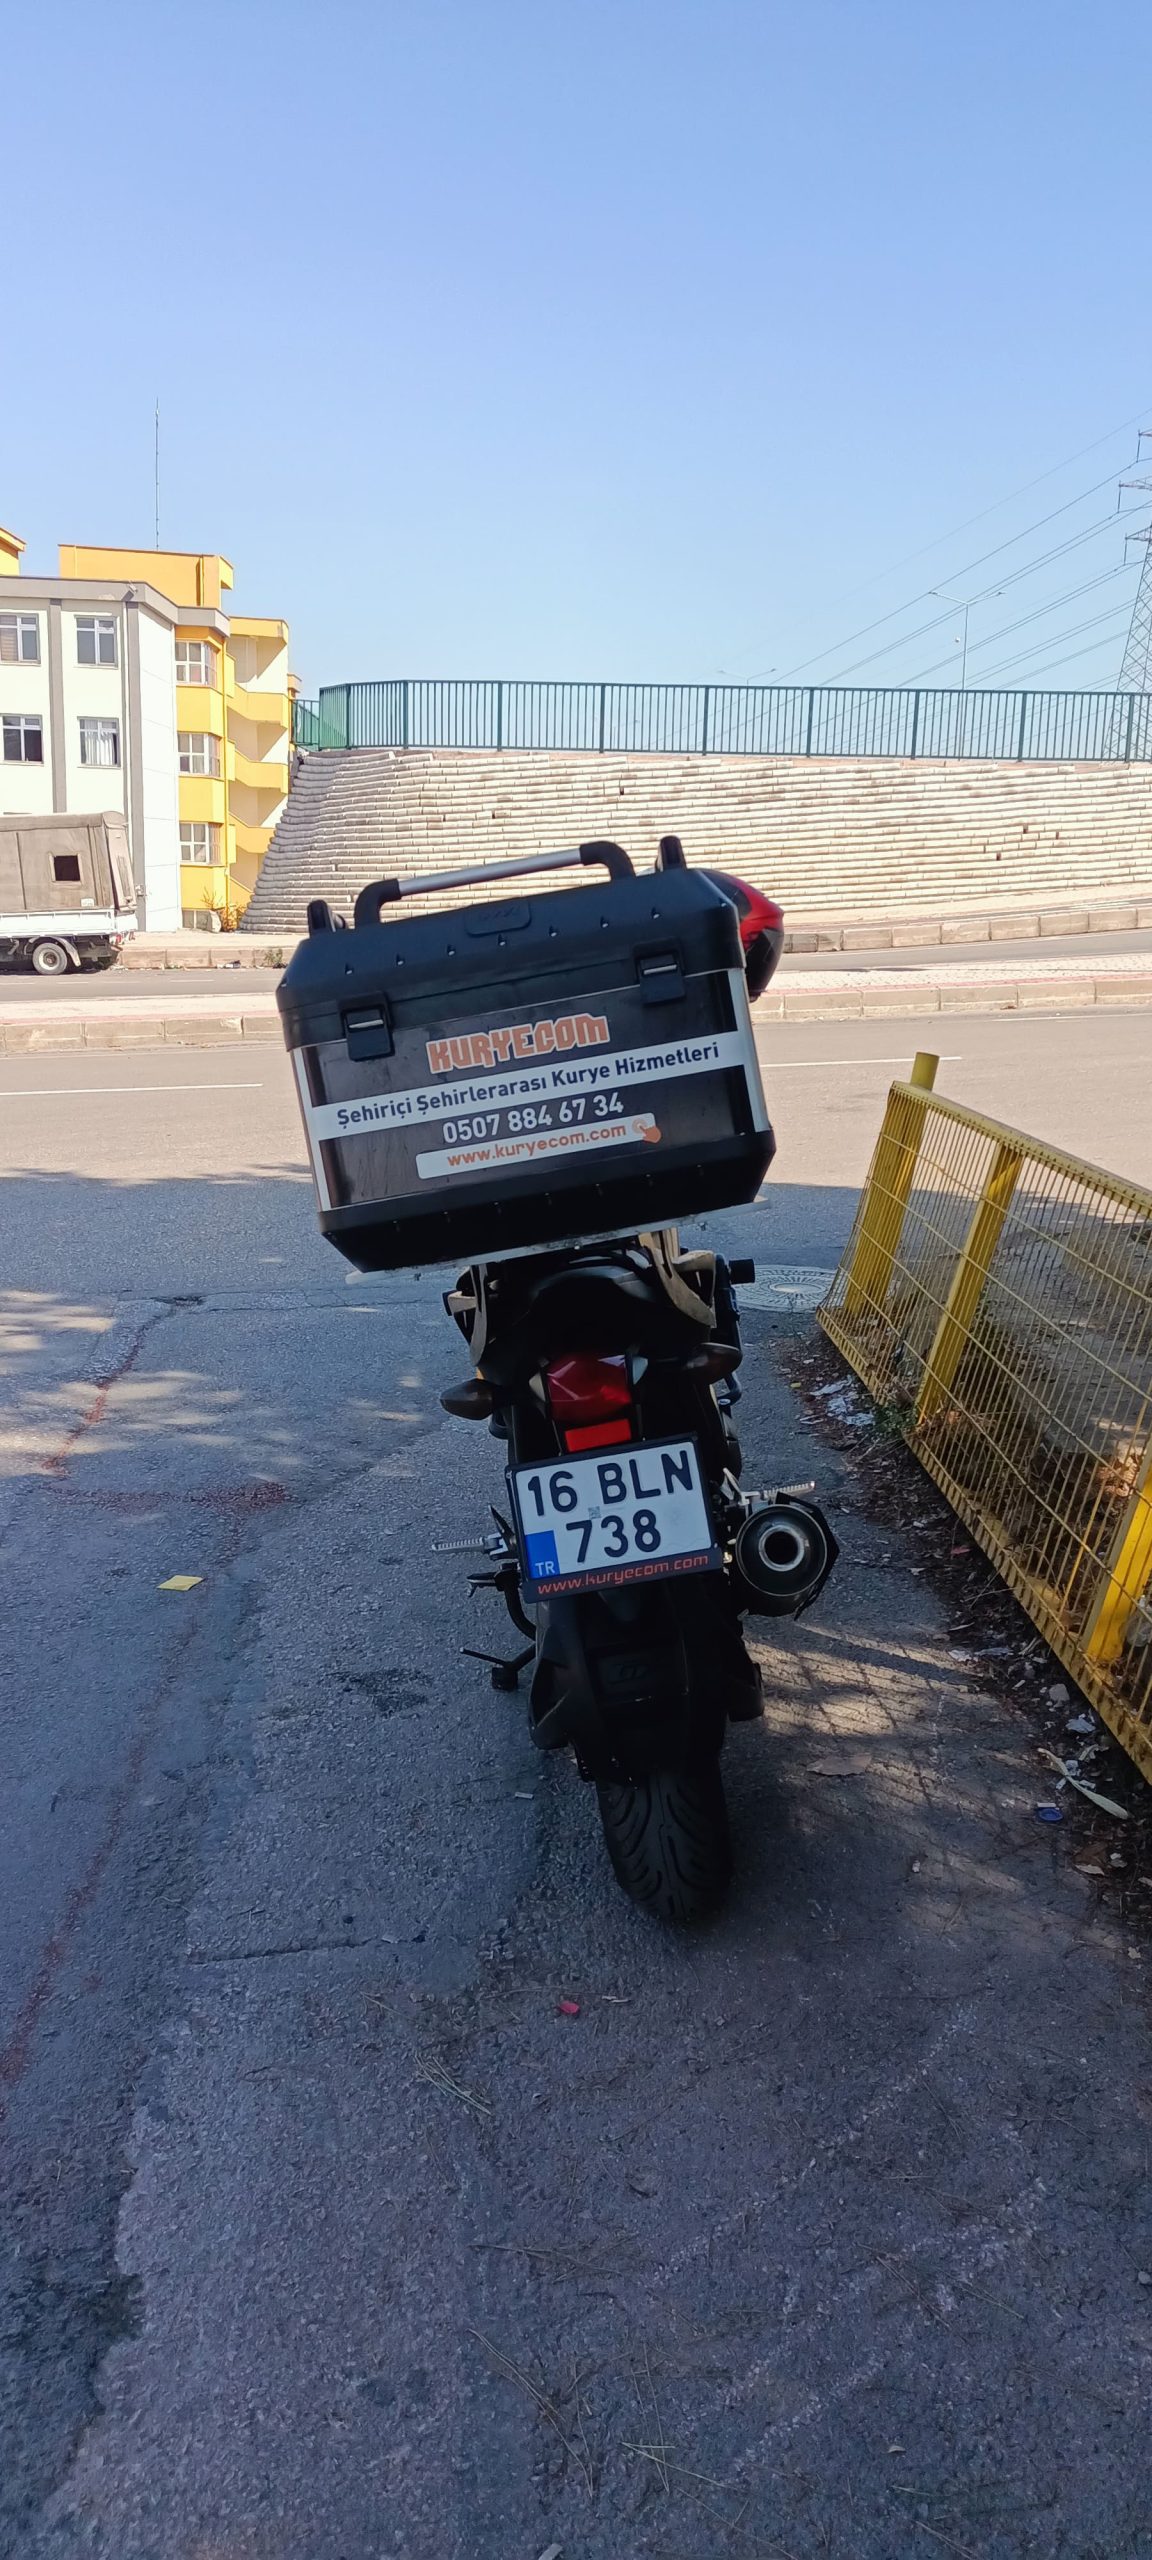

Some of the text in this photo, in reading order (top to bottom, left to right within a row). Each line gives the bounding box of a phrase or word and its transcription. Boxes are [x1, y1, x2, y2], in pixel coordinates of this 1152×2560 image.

[427, 1014, 609, 1073] KURYECOM
[337, 1042, 719, 1129] Şehiriçi Şehirlerarası Kurye Hizmetleri
[443, 1092, 624, 1143] 0507 884 67 34
[447, 1125, 626, 1167] www.kuryecom.com
[527, 1450, 693, 1516] 16 BLN
[566, 1509, 661, 1564] 738
[535, 1561, 555, 1577] TR
[537, 1555, 708, 1595] www.kuryecom.com
